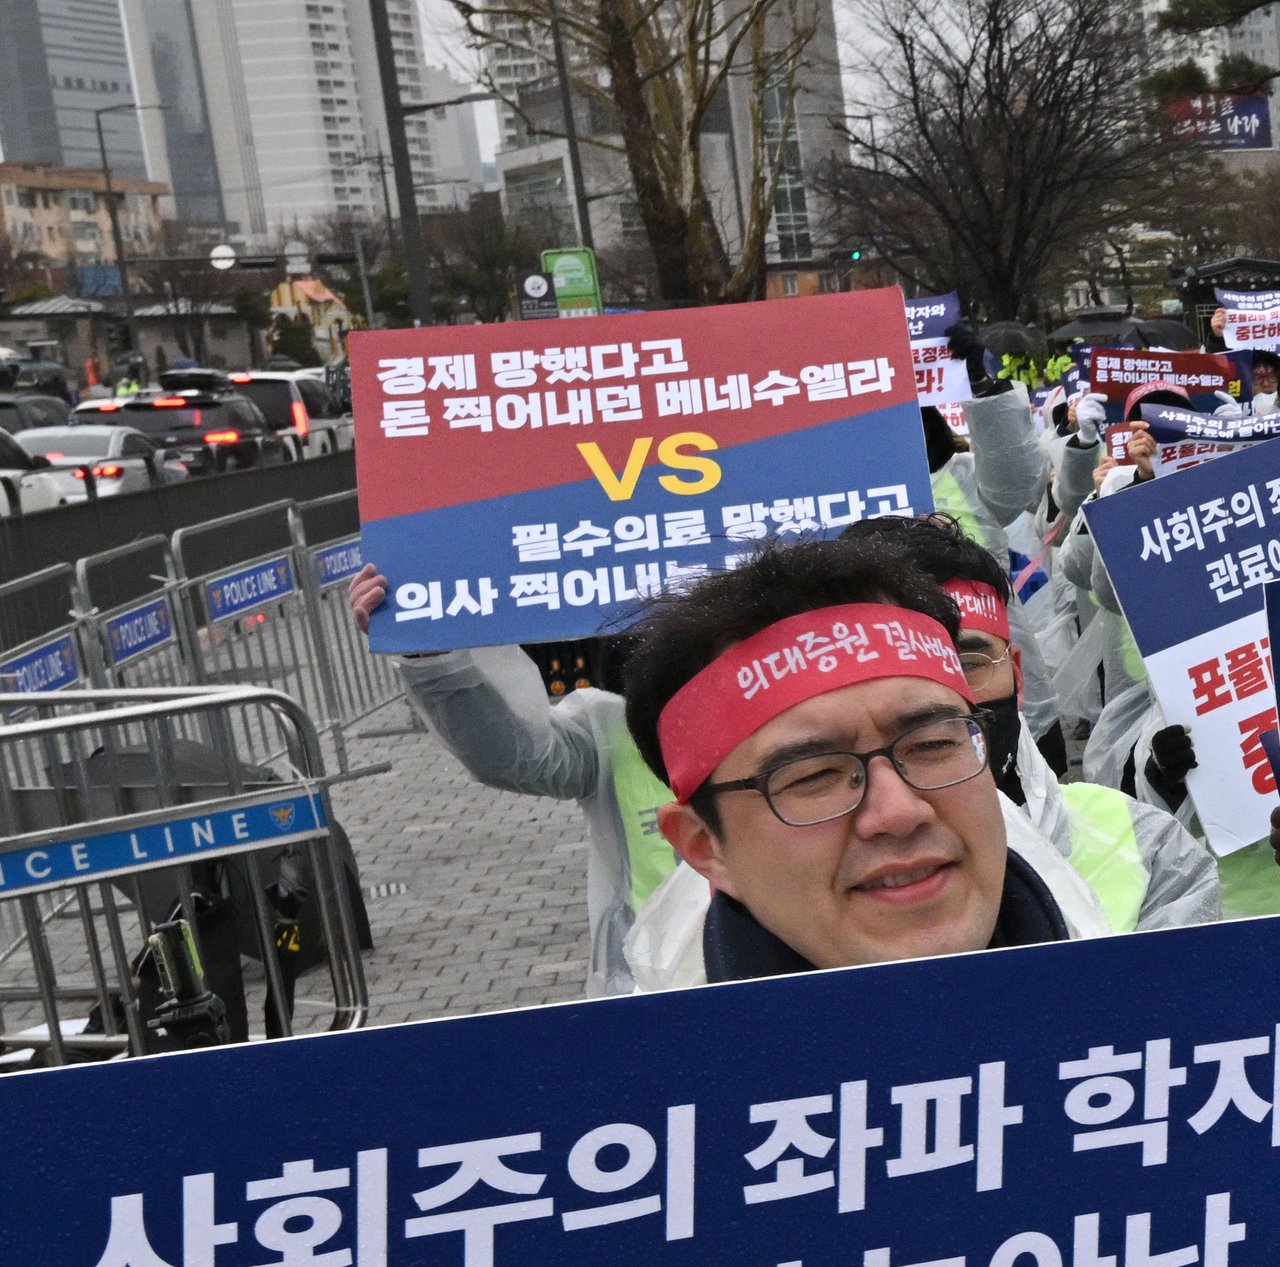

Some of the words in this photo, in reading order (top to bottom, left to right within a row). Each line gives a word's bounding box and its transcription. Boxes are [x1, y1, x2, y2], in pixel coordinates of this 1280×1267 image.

[376, 354, 477, 396] 경제
[490, 338, 689, 388] 망했다고
[379, 399, 431, 438] 돈
[442, 385, 642, 433] 찍어내던
[657, 357, 896, 418] 베네수엘라
[1096, 357, 1120, 370] 경제
[1123, 358, 1173, 373] 망했다고
[576, 431, 723, 502] VS
[511, 509, 712, 563] 필수의료
[720, 484, 914, 543] 망했다고
[1139, 484, 1267, 564] 사회주의
[223, 573, 256, 599] POLICE
[257, 565, 278, 591] LINE
[394, 576, 498, 623] 의사
[736, 621, 880, 700] 의대증원
[1187, 636, 1270, 718] 포퓰
[131, 812, 250, 860] LINE
[743, 1060, 1024, 1215] 좌파
